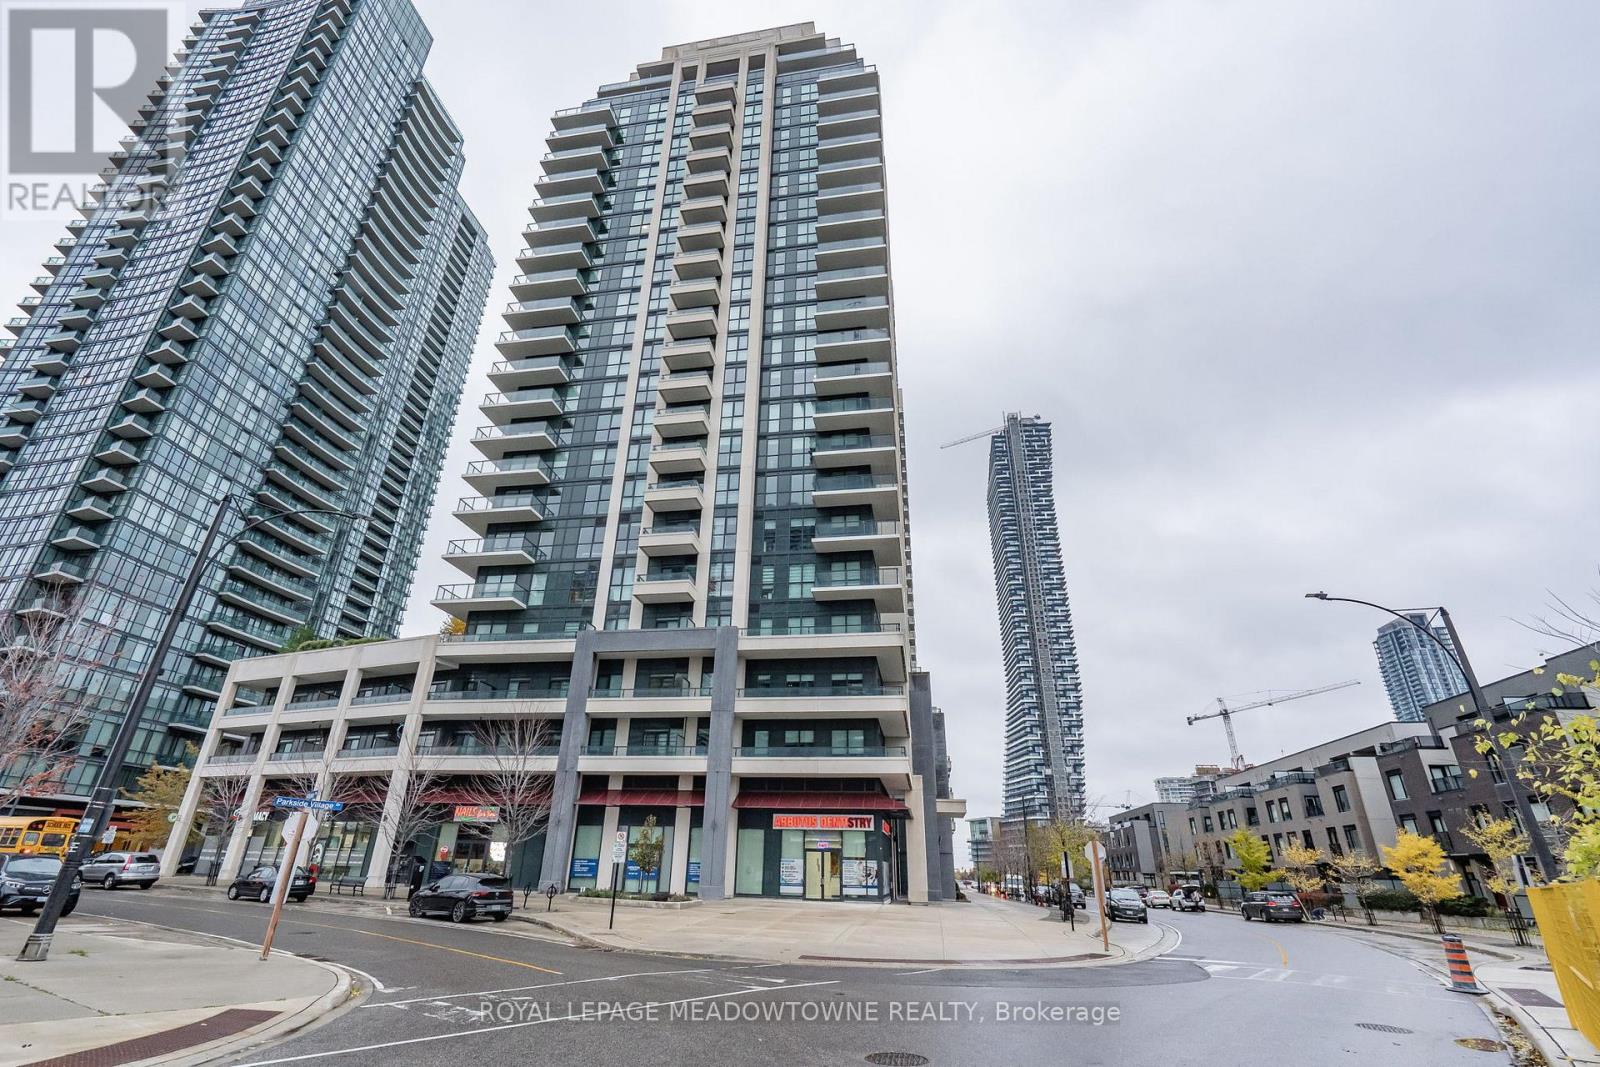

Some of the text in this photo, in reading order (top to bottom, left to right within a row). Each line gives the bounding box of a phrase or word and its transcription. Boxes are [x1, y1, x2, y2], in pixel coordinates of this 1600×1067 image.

[276, 798, 308, 809] Parkside
[310, 801, 334, 810] Village
[455, 807, 477, 817] NAILS
[774, 816, 817, 828] ARBUTUS
[820, 816, 872, 828] DENTISTRY
